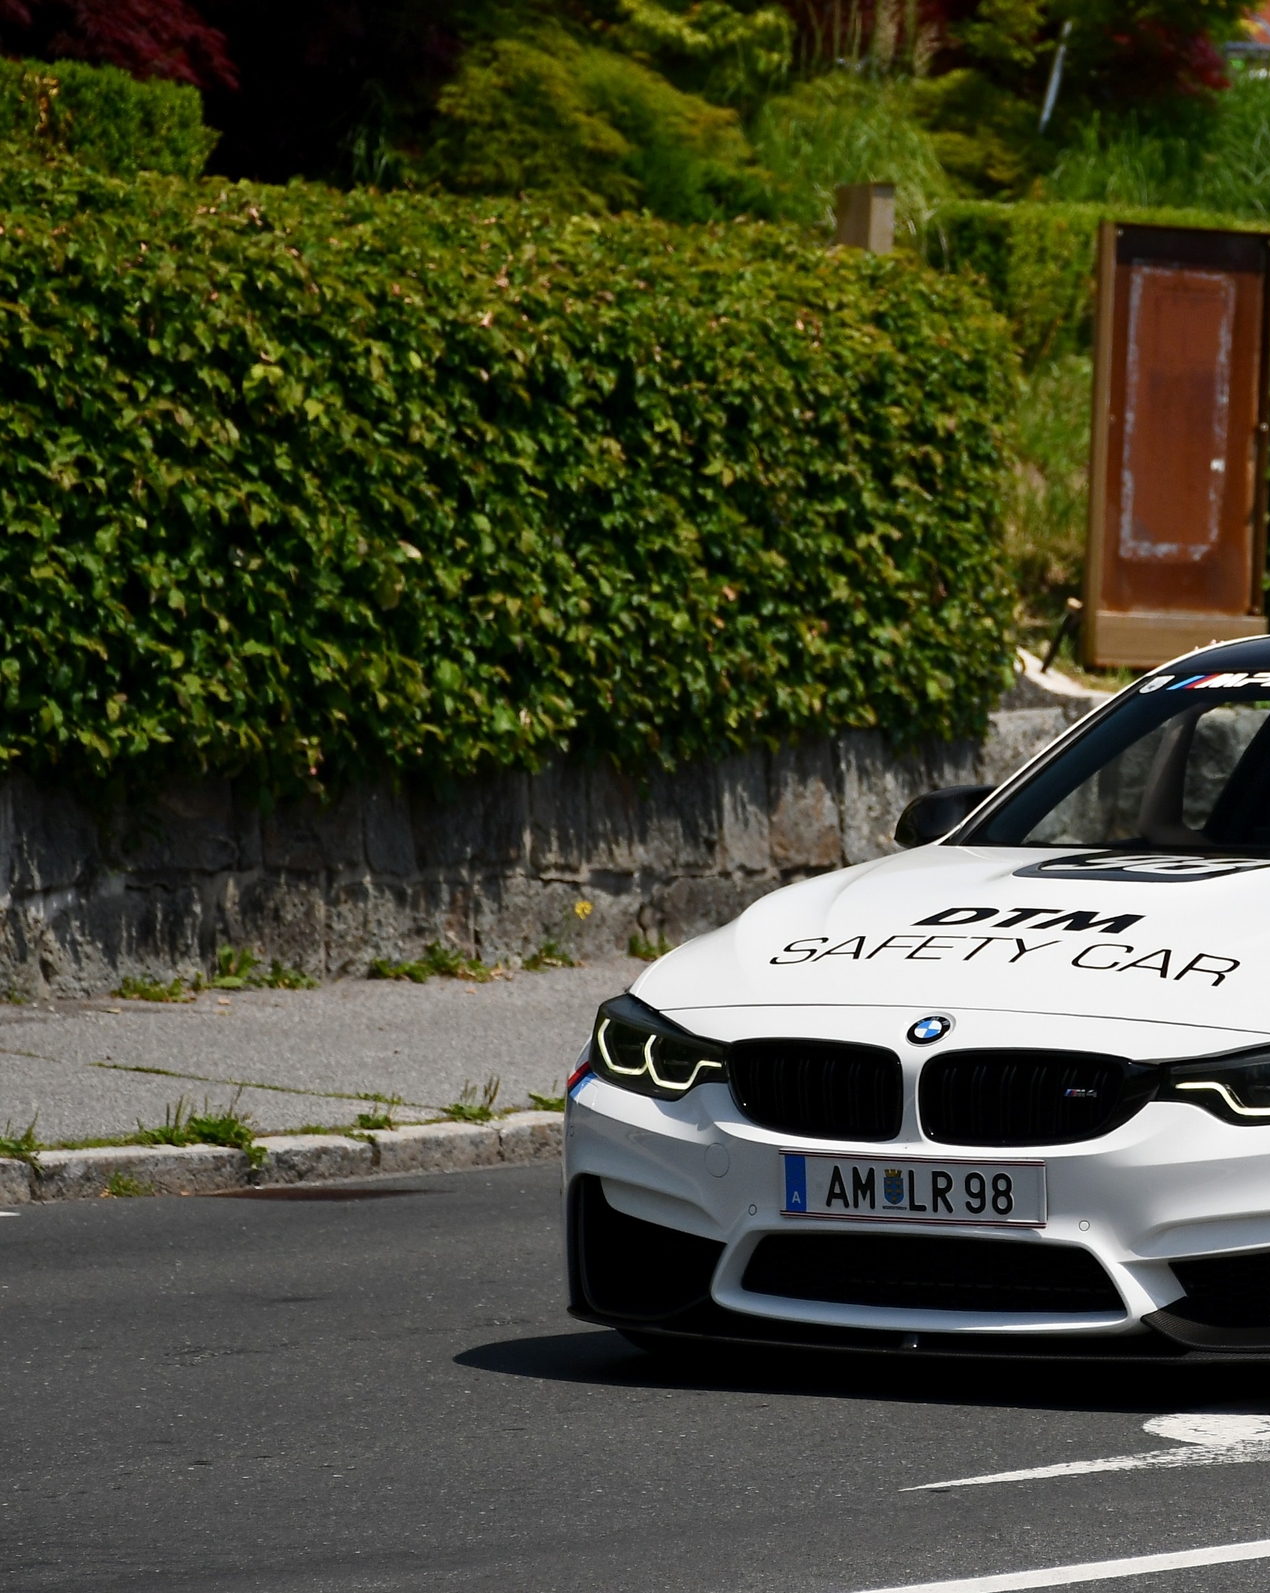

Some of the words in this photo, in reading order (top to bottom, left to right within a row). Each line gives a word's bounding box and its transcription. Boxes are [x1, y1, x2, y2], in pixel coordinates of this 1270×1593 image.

[912, 908, 1146, 934] DTM
[769, 935, 1061, 965] SAFETY
[1071, 944, 1241, 986] CAR
[791, 1191, 801, 1204] A
[826, 1165, 876, 1210] AM
[907, 1170, 954, 1214] LR
[965, 1172, 1014, 1216] 98
